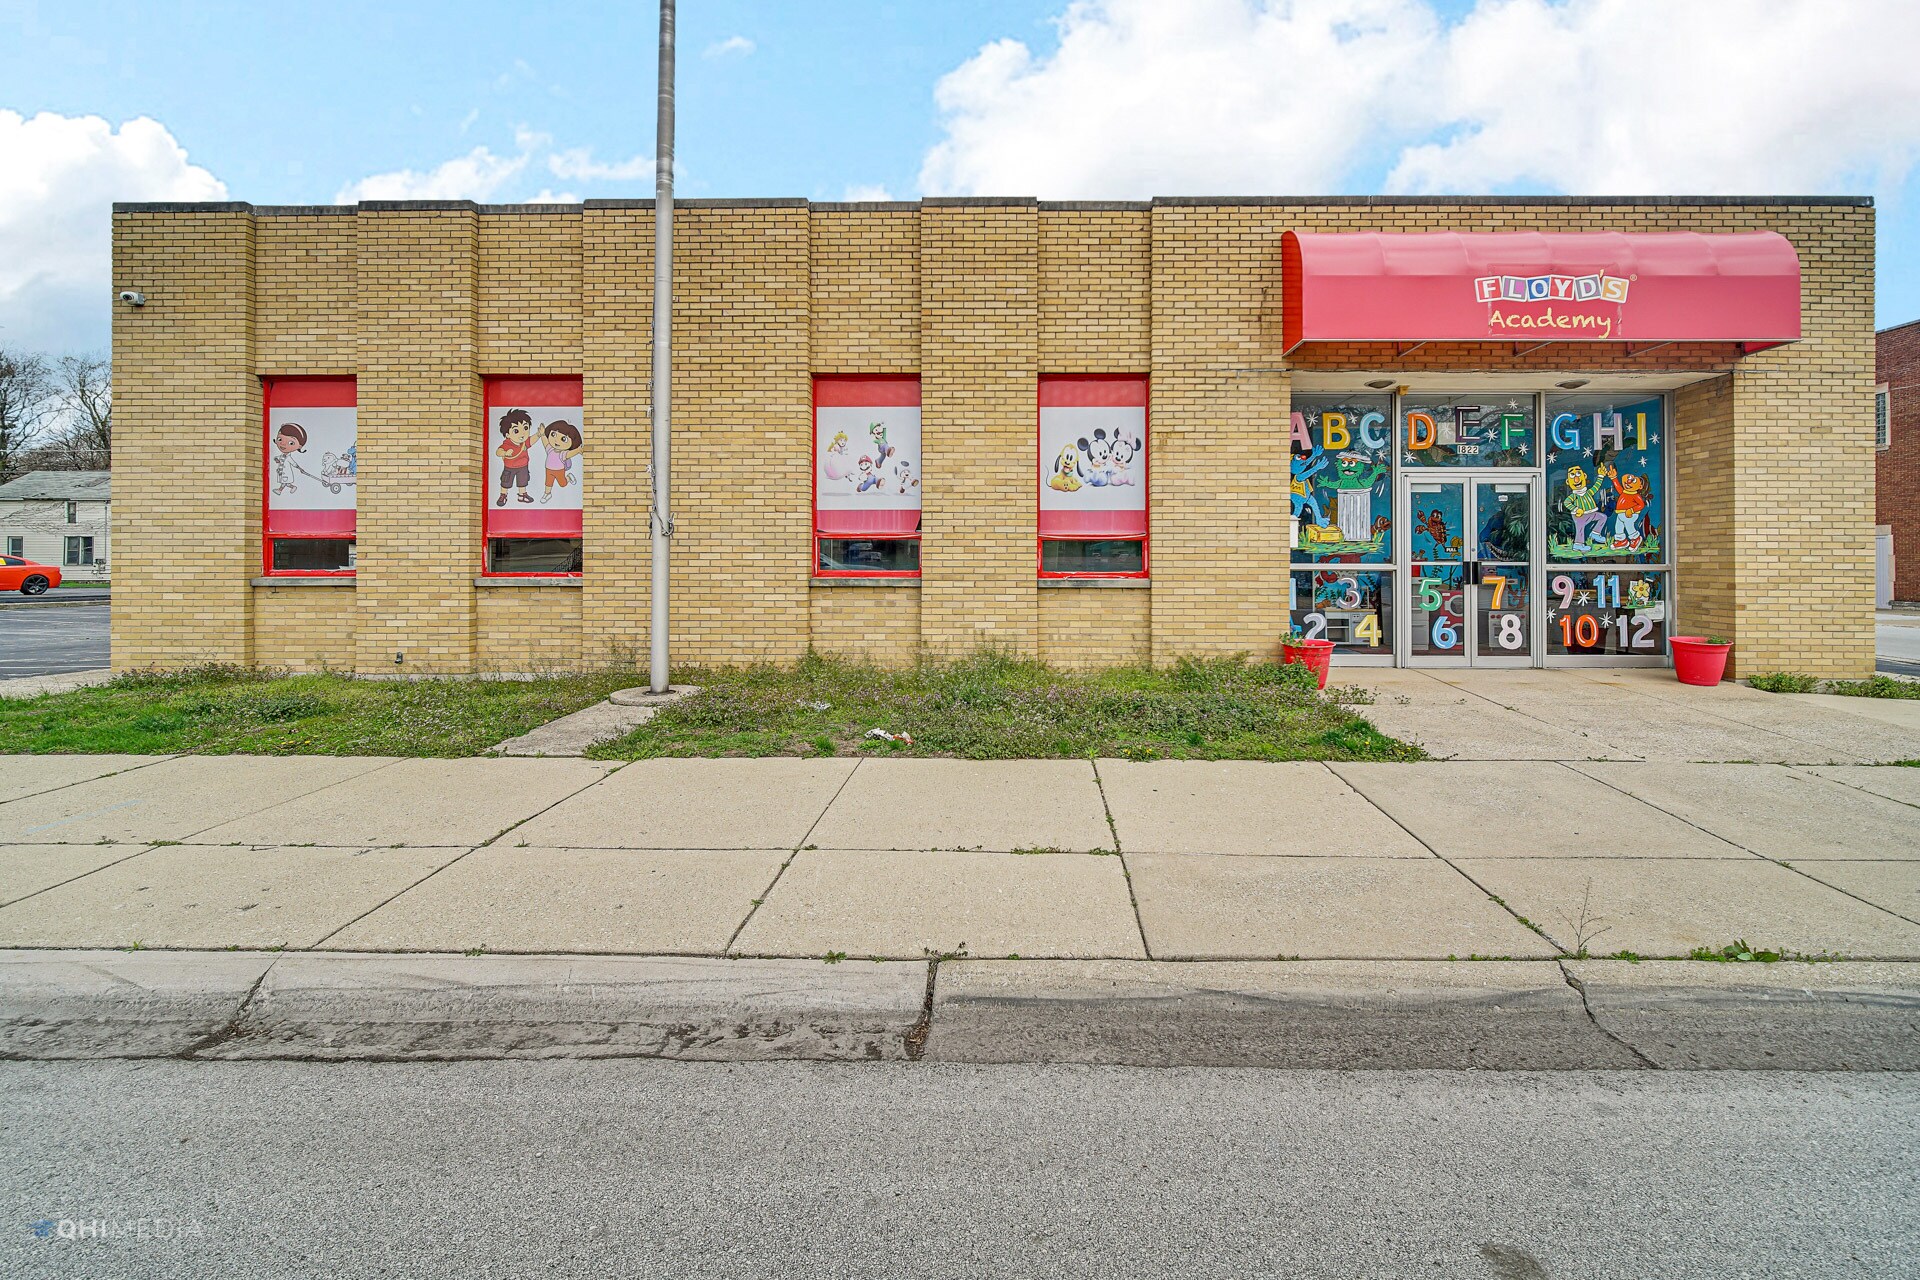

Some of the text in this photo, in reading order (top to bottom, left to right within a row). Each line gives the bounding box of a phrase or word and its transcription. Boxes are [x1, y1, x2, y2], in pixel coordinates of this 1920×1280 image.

[1480, 269, 1625, 300] FLOYD'S
[1490, 307, 1611, 339] Academy
[1458, 446, 1479, 454] 1822
[1419, 577, 1443, 612] 5
[1482, 576, 1506, 610] 7
[1551, 575, 1575, 609] 9
[1593, 575, 1621, 609] 11
[1354, 614, 1382, 647] 4
[1432, 616, 1458, 650] 6
[1498, 613, 1523, 650] 8
[1559, 614, 1599, 648] 10
[1616, 614, 1655, 648] 12
